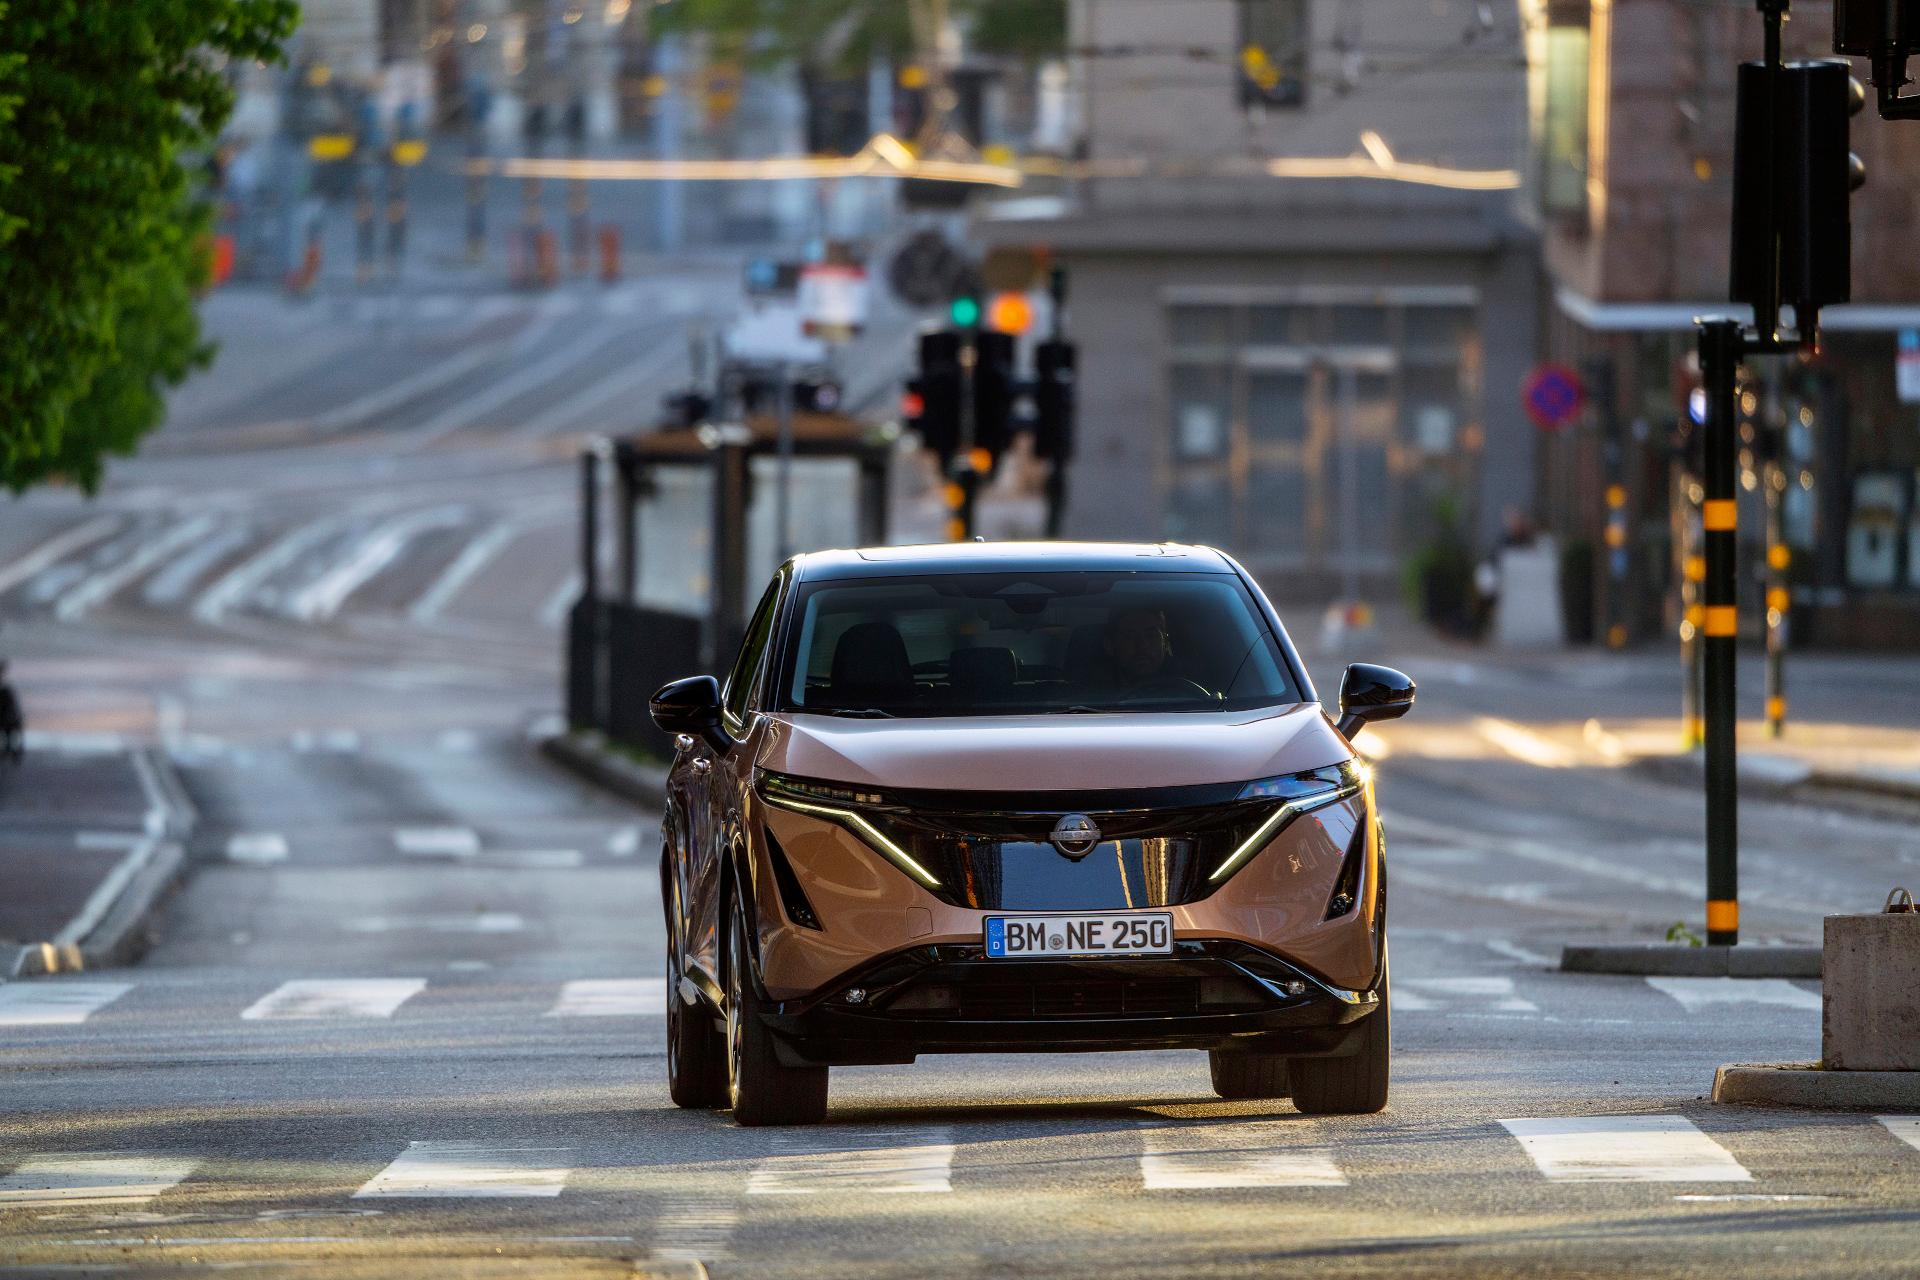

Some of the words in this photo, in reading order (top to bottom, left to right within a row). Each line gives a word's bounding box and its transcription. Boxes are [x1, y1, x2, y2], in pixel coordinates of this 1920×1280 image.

[1006, 922, 1045, 951] BM
[1067, 920, 1106, 949] NE
[1112, 919, 1167, 948] 250
[993, 942, 1000, 950] D
